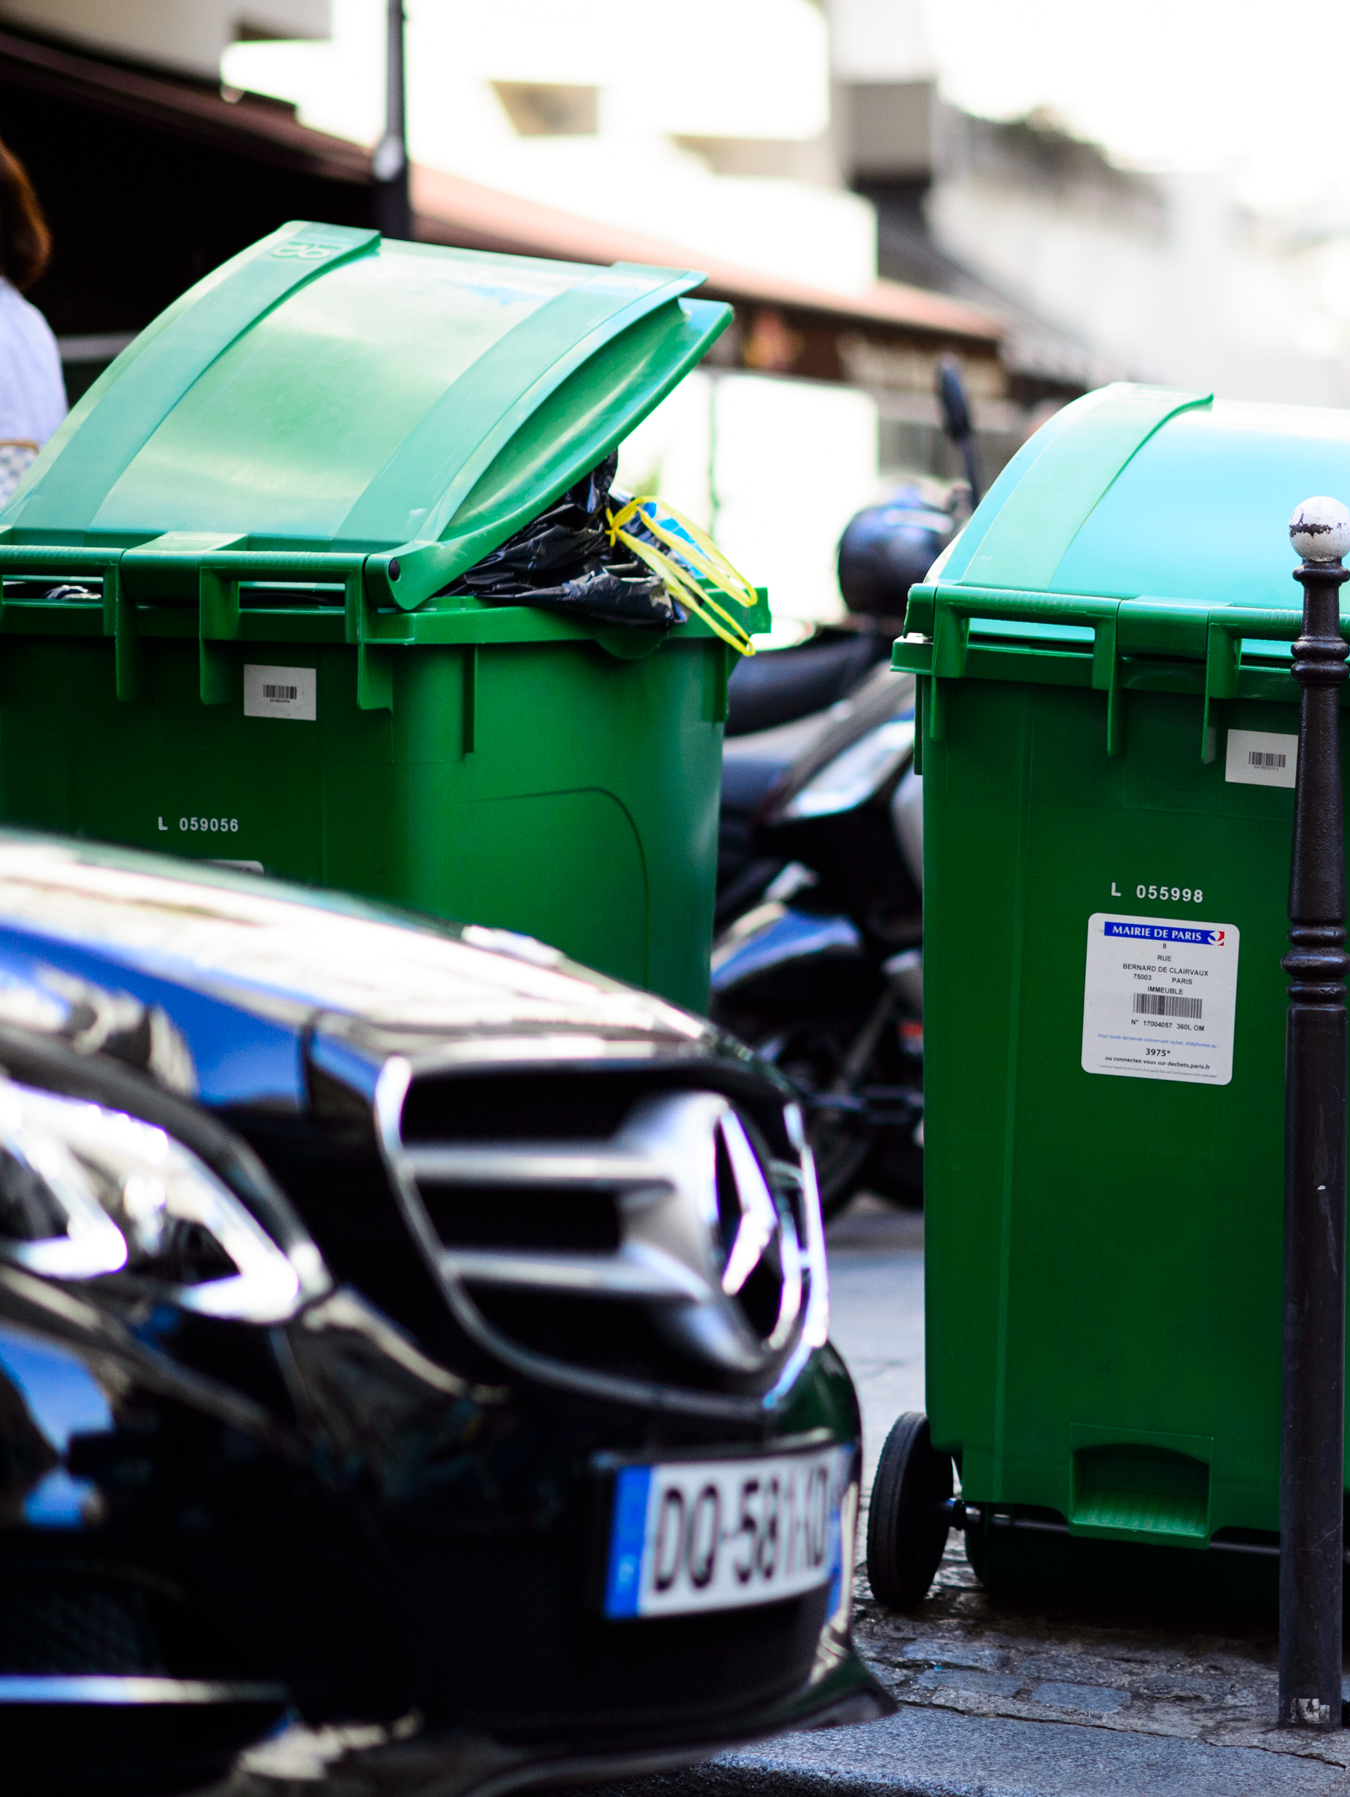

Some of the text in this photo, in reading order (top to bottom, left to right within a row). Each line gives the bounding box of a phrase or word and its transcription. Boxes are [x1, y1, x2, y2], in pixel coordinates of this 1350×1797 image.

[158, 816, 239, 832] L 059056
[1110, 882, 1204, 903] L 055998
[1112, 925, 1202, 942] MAIRIE DE PARIS
[1157, 954, 1172, 963] RUE
[1122, 963, 1209, 977] BERNARD DE CLAIRVAUX
[1133, 973, 1193, 985] 75003 PARIS
[1147, 986, 1184, 995] IMMEUBLE
[1113, 1056, 1157, 1065] connectez-vous
[1167, 1061, 1211, 1070] dechets.paris.fr
